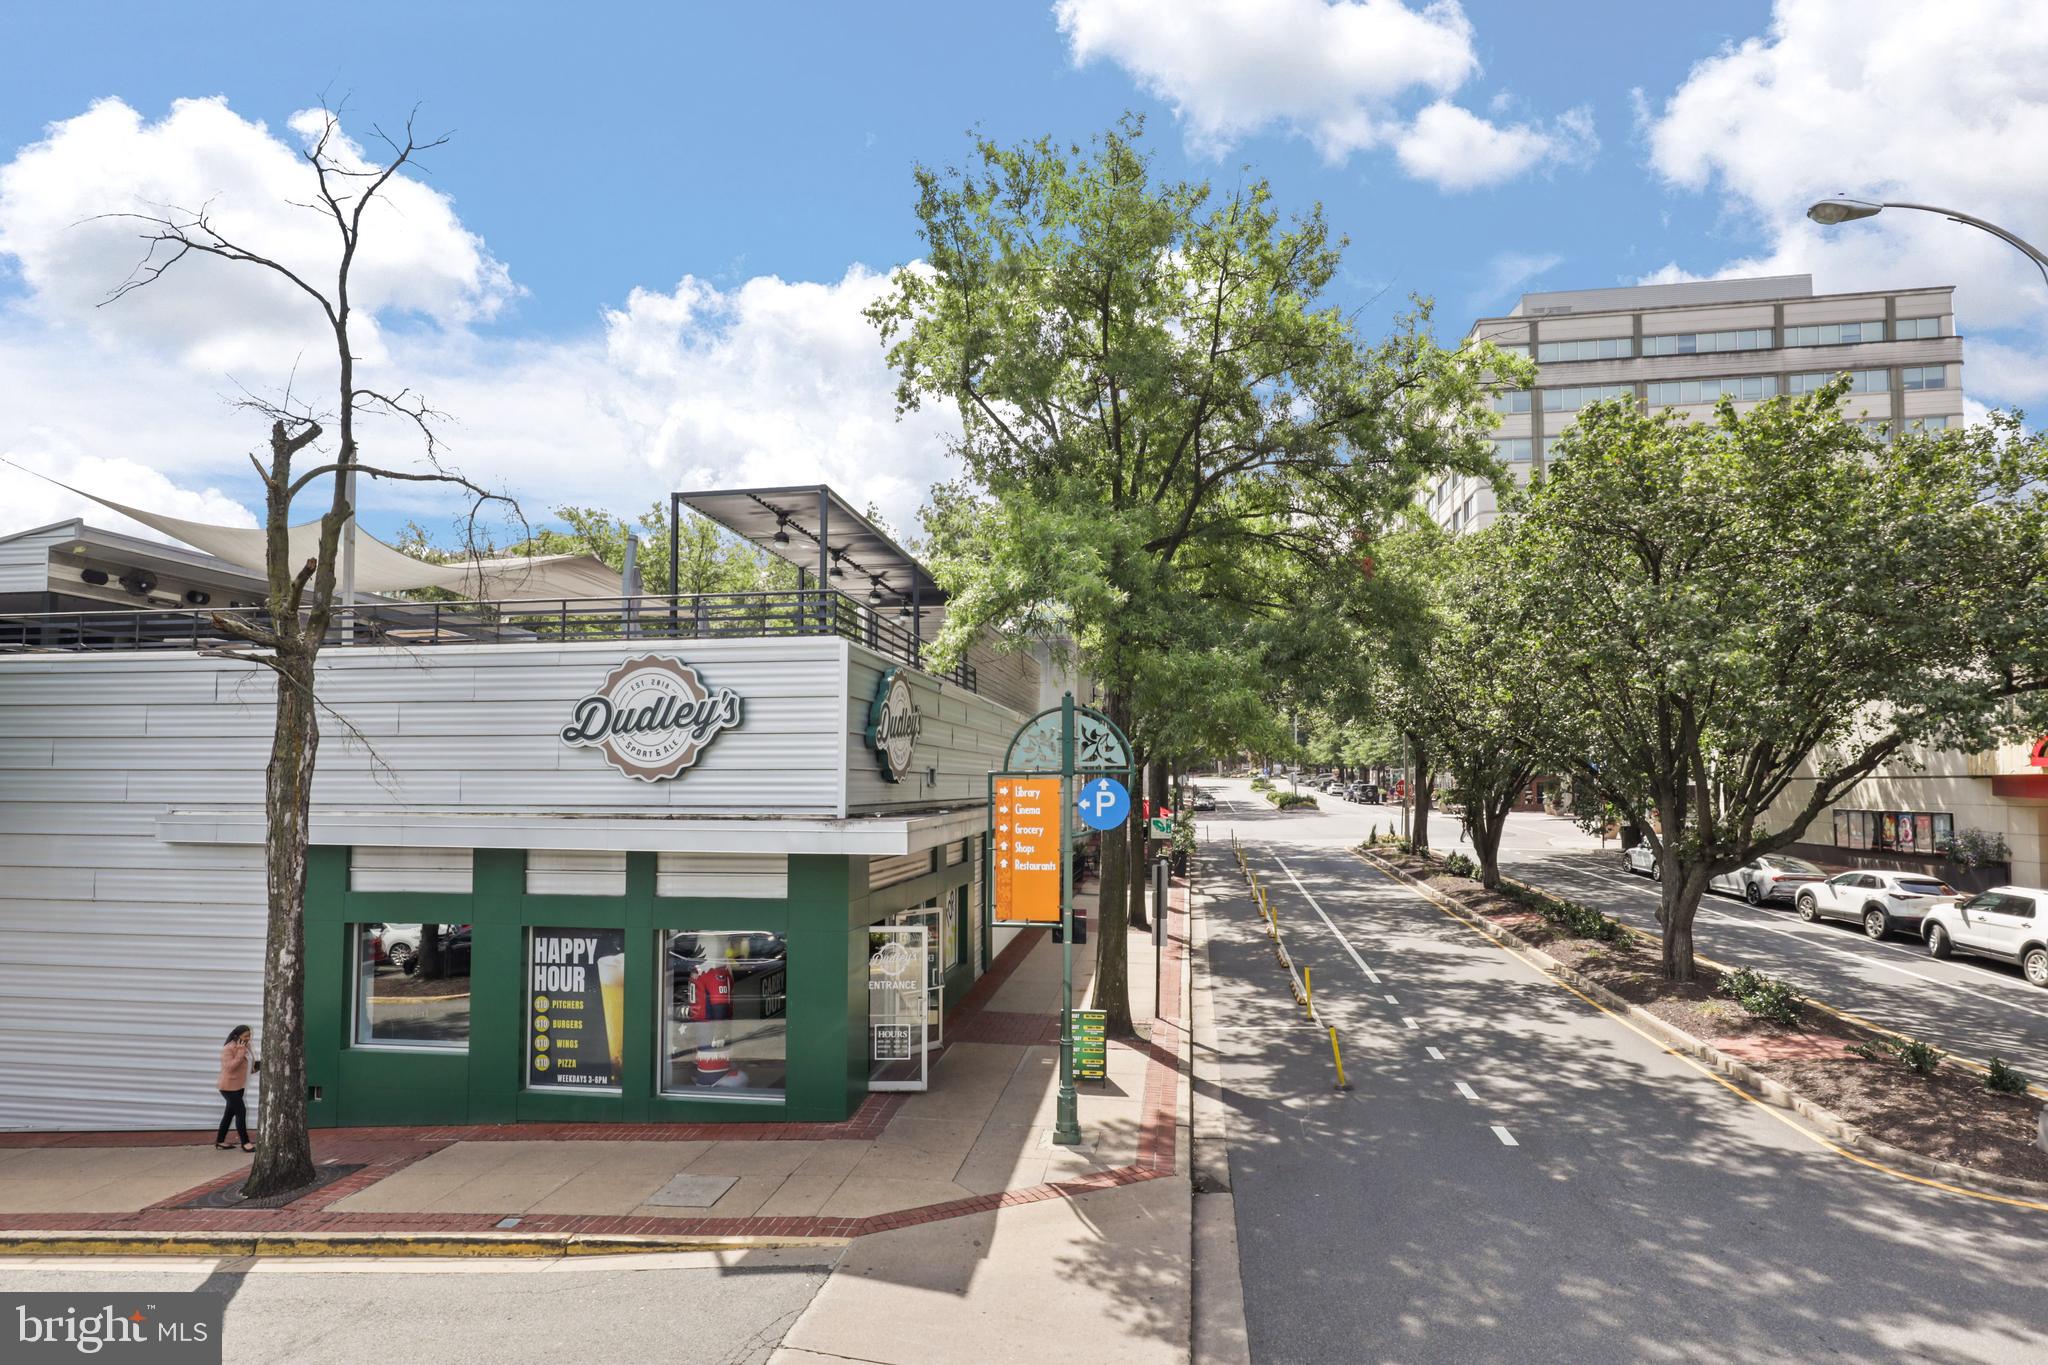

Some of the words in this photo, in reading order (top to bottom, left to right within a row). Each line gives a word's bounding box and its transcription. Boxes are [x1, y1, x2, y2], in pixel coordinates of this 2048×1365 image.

[630, 680, 645, 690] EST
[562, 689, 737, 742] Dudley's
[655, 748, 662, 758] &
[1014, 785, 1041, 800] Library
[1014, 803, 1041, 815] Cinema
[1096, 791, 1116, 817] P
[1014, 822, 1045, 838] Grocery
[1014, 841, 1035, 855] Shops
[1014, 859, 1057, 871] Restaurants
[534, 937, 598, 965] HAPPY
[534, 965, 586, 993] HOUR
[869, 980, 917, 990] ENTRANCE
[762, 974, 785, 998] CARRY
[552, 999, 585, 1010] PITCHERS
[765, 993, 782, 1016] OUT
[552, 1019, 583, 1029] BURGERS
[878, 1030, 908, 1039] HOURS
[556, 1039, 579, 1049] WINGS
[557, 1058, 577, 1069] PIZZA
[557, 1074, 587, 1084] WEEKDAYS
[588, 1075, 608, 1085] 3-6PM
